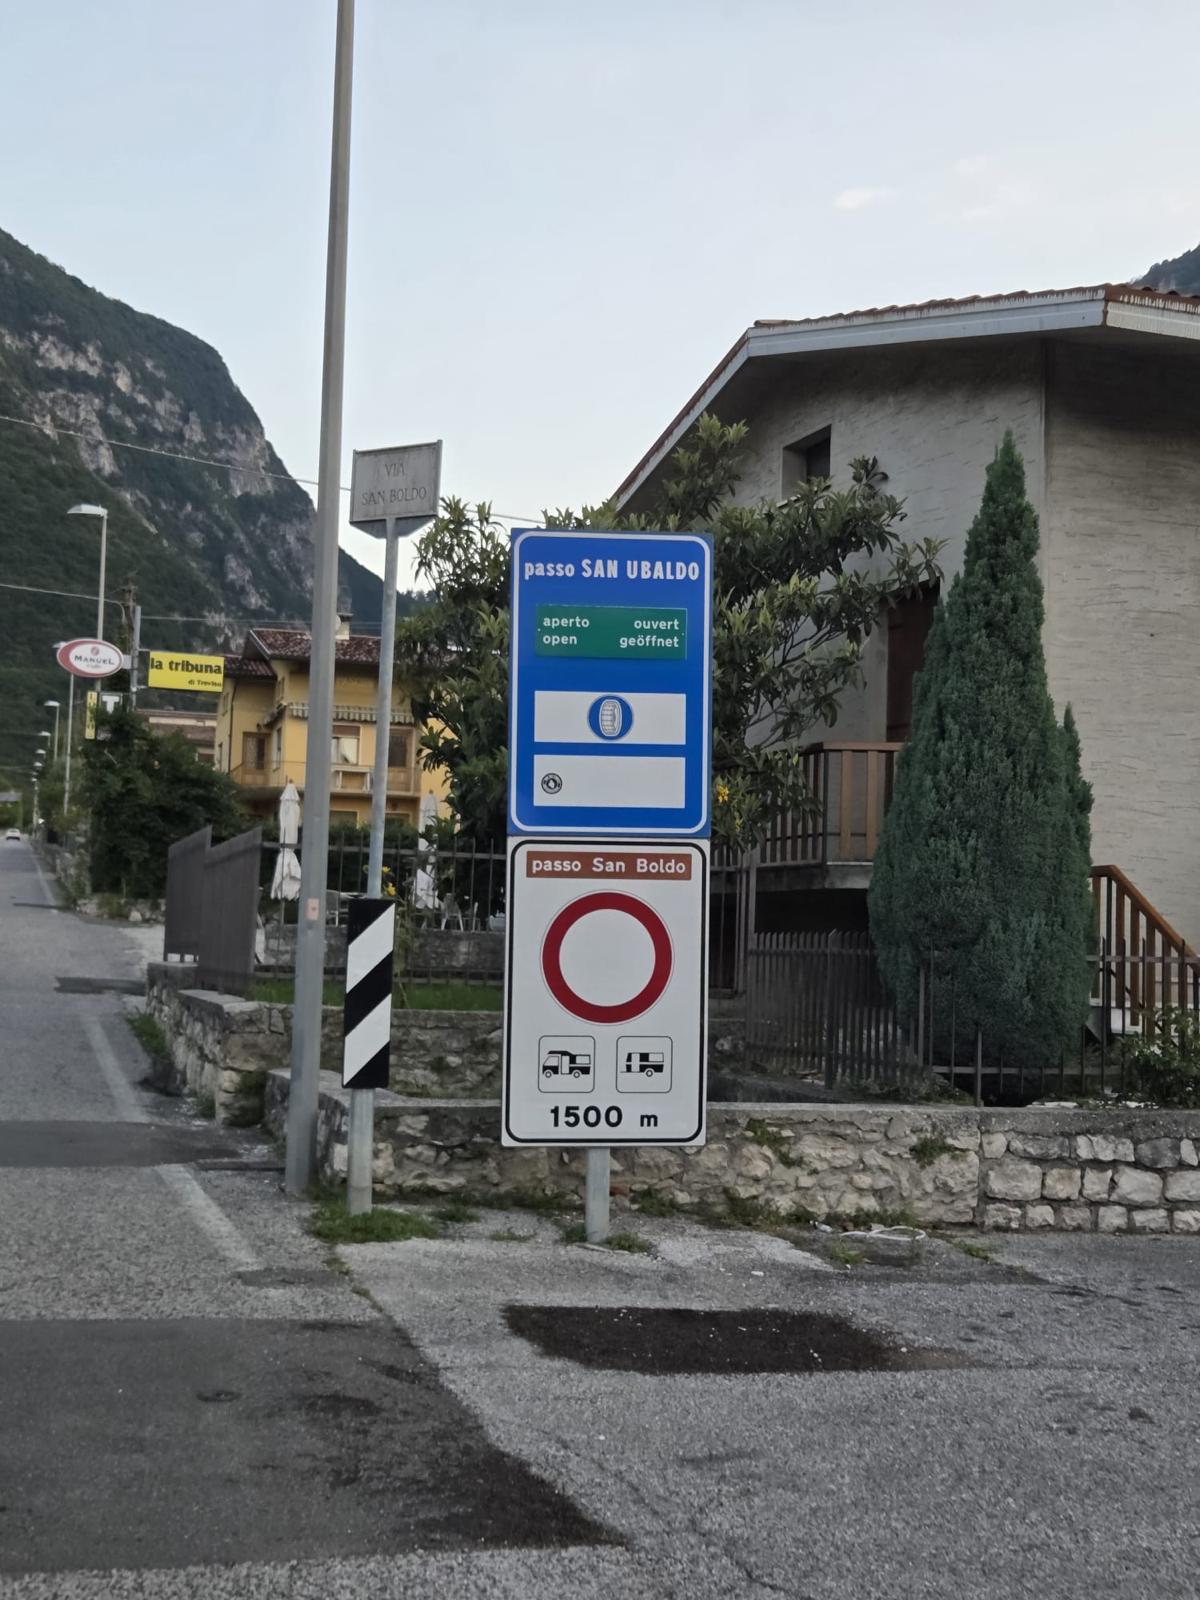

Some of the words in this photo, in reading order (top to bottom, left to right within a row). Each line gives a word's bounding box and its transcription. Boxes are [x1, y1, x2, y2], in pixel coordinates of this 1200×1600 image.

[384, 463, 406, 478] VIA
[361, 490, 385, 505] SAN
[390, 486, 427, 503] BOLDO
[524, 561, 575, 580] passo
[581, 558, 618, 578] SAN
[626, 560, 700, 580] UBALDO
[543, 616, 590, 628] aperto
[633, 618, 680, 630] ouvert
[542, 634, 578, 645] open
[619, 635, 680, 648] geöffnet
[74, 655, 116, 665] MANUEL
[150, 657, 163, 670] la
[168, 659, 222, 674] tribuna
[532, 859, 581, 873] passo
[592, 857, 625, 873] San
[636, 858, 686, 873] Boldo
[550, 1105, 623, 1128] 1500
[640, 1114, 658, 1127] m
